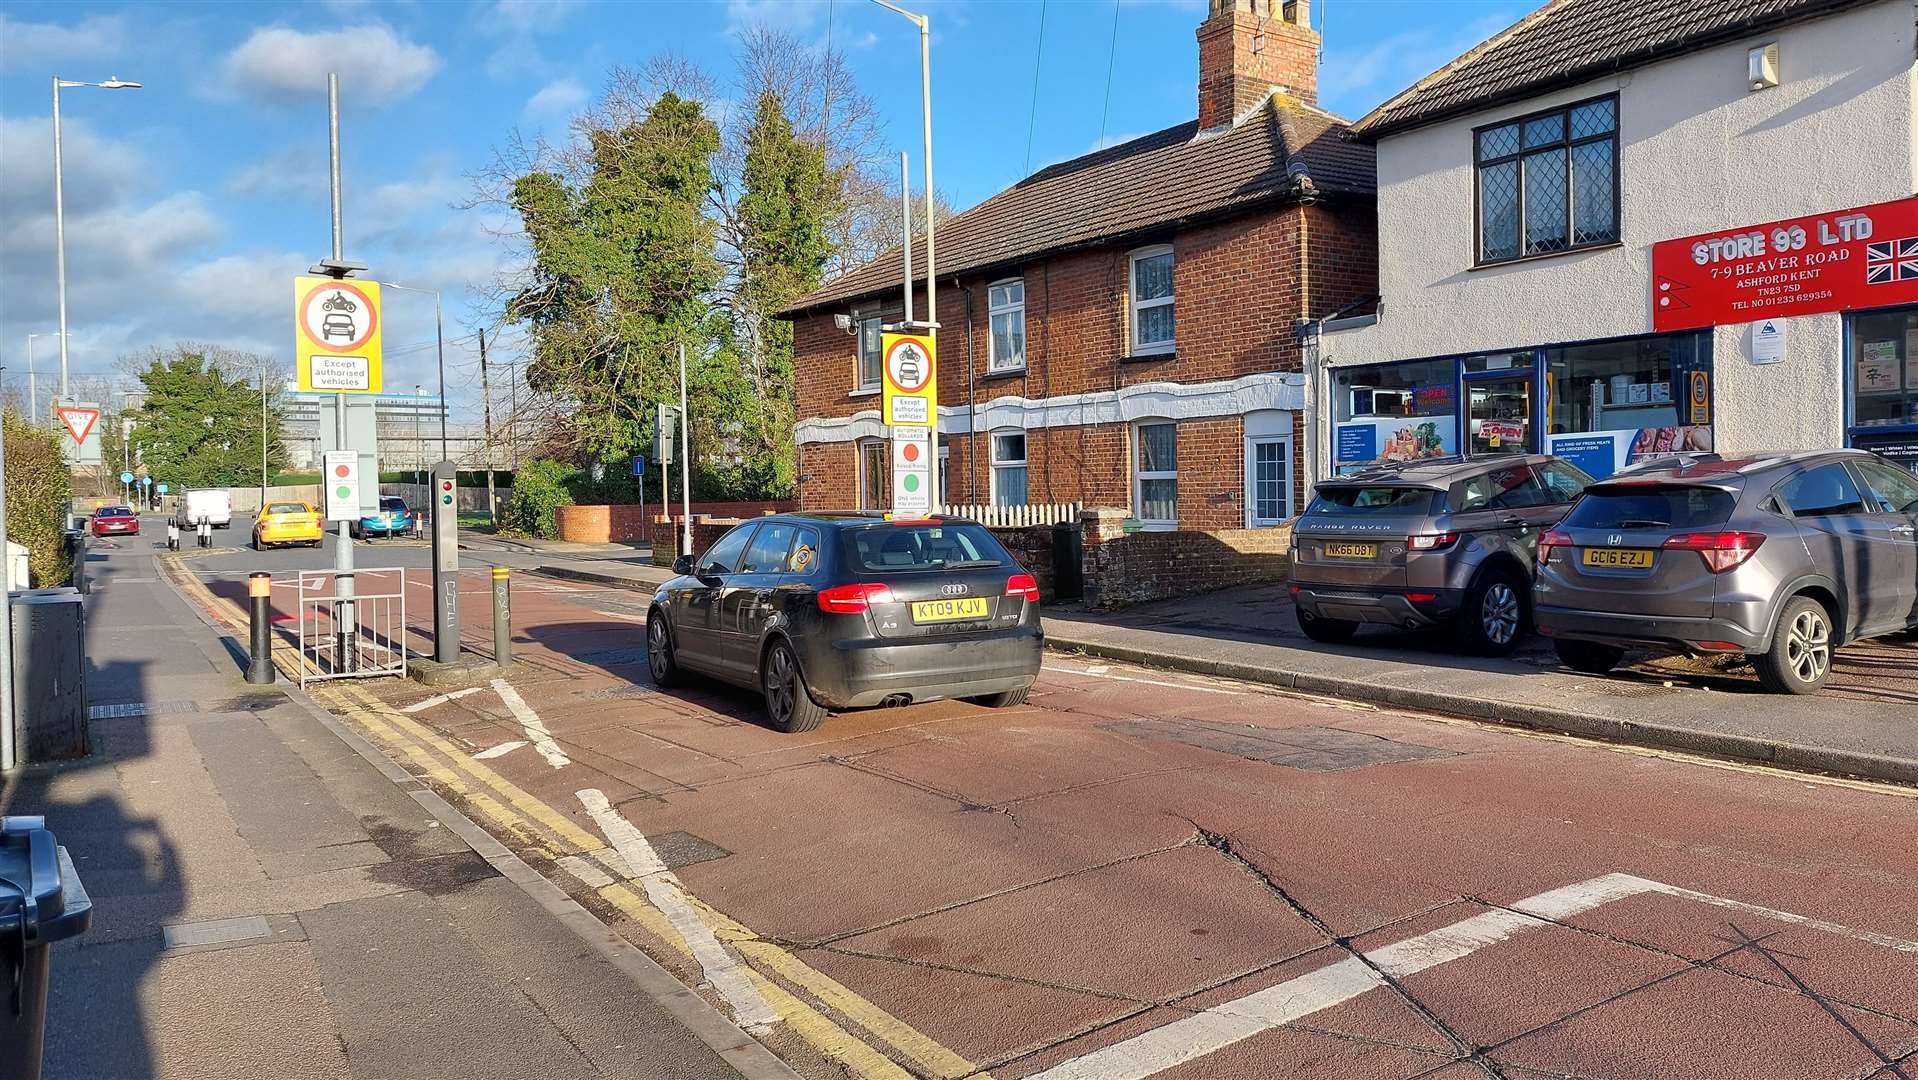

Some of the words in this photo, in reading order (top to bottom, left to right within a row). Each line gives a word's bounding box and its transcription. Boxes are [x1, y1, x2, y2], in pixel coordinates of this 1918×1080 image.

[1692, 232, 1766, 265] STORE
[1771, 225, 1807, 253] 93
[1817, 214, 1873, 246] LTD
[1711, 266, 1732, 280] 7-9
[1736, 257, 1799, 276] BEAVER
[1805, 248, 1850, 265] ROAD
[1736, 273, 1788, 289] ASHFORD
[1790, 268, 1821, 281] KENT
[1757, 286, 1781, 297] TN23
[1783, 283, 1801, 293] 7SD
[1732, 302, 1749, 310] TEL
[1751, 299, 1764, 308] NO
[1765, 295, 1795, 306] 01233
[1796, 290, 1832, 302] 629354
[324, 360, 356, 369] Except
[315, 368, 365, 378] authorised
[321, 378, 360, 386] vehicles
[899, 399, 921, 407] Except
[67, 413, 89, 421] GIVE
[1491, 426, 1522, 438] OPEN
[1329, 543, 1353, 555] NK66
[1354, 545, 1374, 556] OBT
[1590, 550, 1618, 564] GC16
[1620, 551, 1646, 565] EZJ
[918, 602, 954, 617] KT09
[956, 600, 981, 614] KJV
[882, 620, 898, 629] A3
